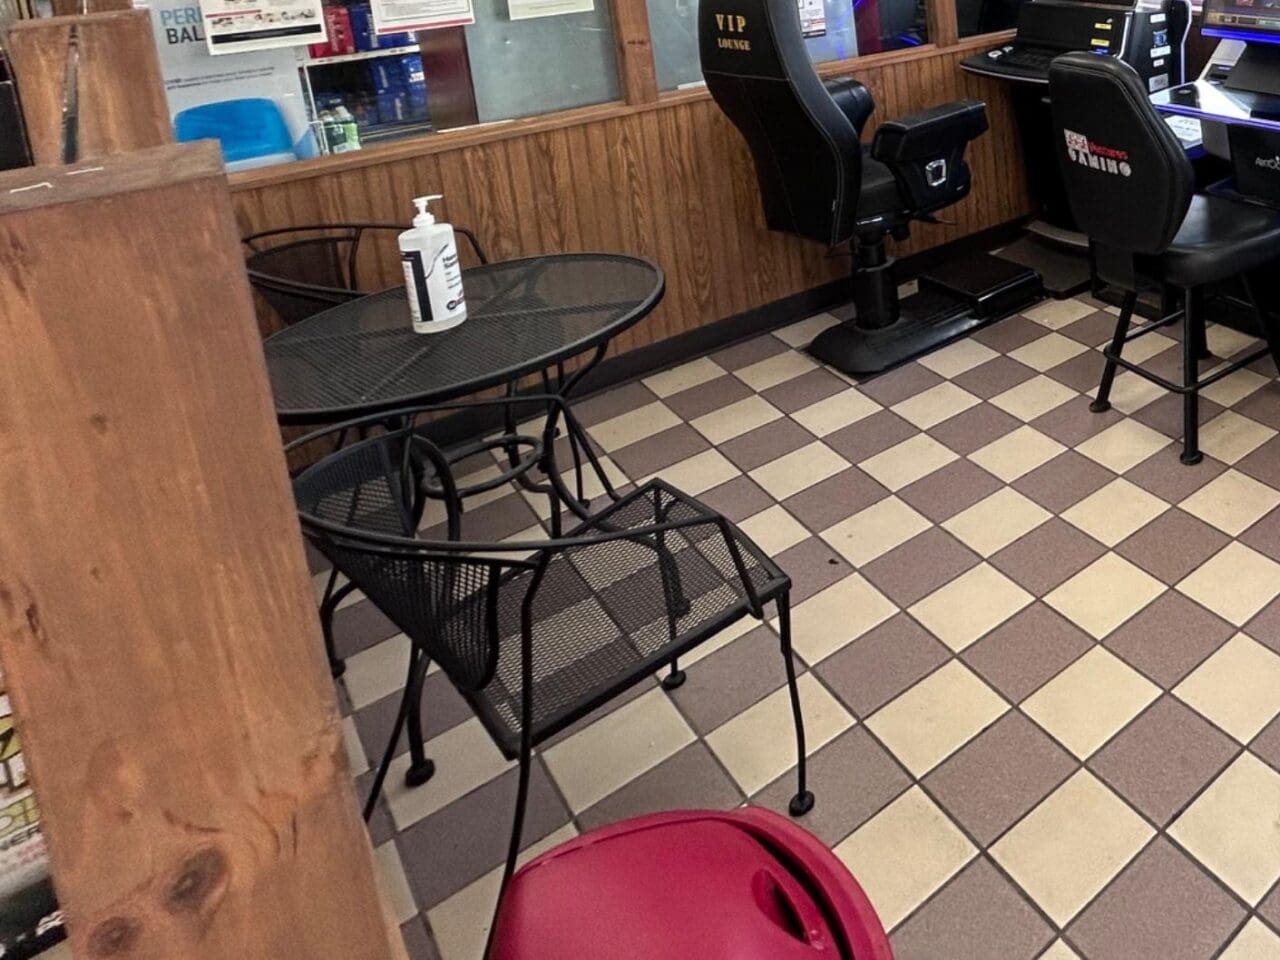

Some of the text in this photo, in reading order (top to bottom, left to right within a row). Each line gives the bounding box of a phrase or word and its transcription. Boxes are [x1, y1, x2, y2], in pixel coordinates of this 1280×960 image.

[715, 13, 747, 33] VIP
[717, 36, 751, 52] LOUNGE
[1068, 147, 1132, 177] GAMING
